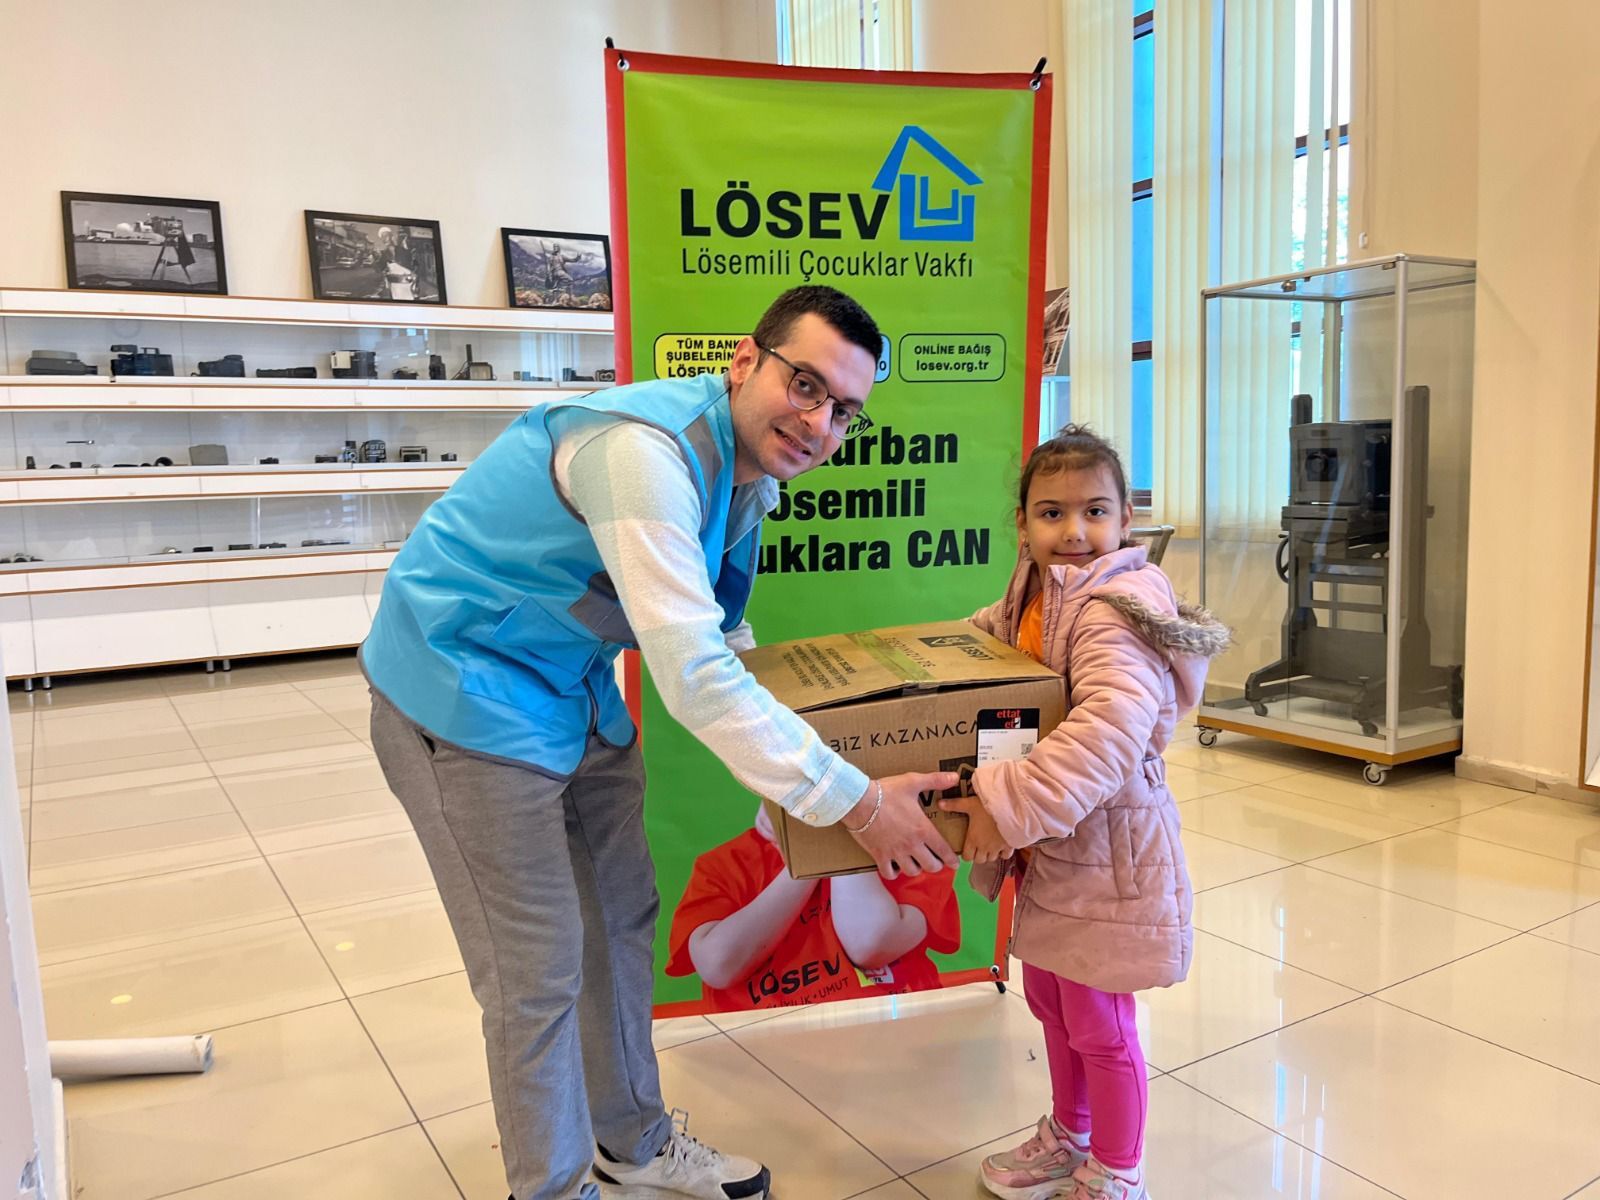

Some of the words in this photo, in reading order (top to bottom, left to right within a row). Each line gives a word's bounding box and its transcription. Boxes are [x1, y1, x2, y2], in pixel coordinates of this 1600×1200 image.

[681, 181, 890, 240] LÖSEV
[682, 248, 790, 275] Lösemili
[799, 250, 909, 282] Çocuklar
[914, 251, 974, 278] Vakfı
[666, 350, 734, 363] ŞUBELERİN
[677, 337, 703, 349] TÜM
[708, 339, 740, 349] BANK
[958, 343, 991, 357] BAĞIŞ
[916, 359, 989, 372] losev.org.tr
[818, 426, 958, 467] urban
[762, 478, 926, 521] ösemili
[757, 533, 890, 575] uklara
[907, 528, 990, 568] CAN
[870, 719, 977, 747] KAZANACA
[748, 952, 841, 1005] LÖSEV
